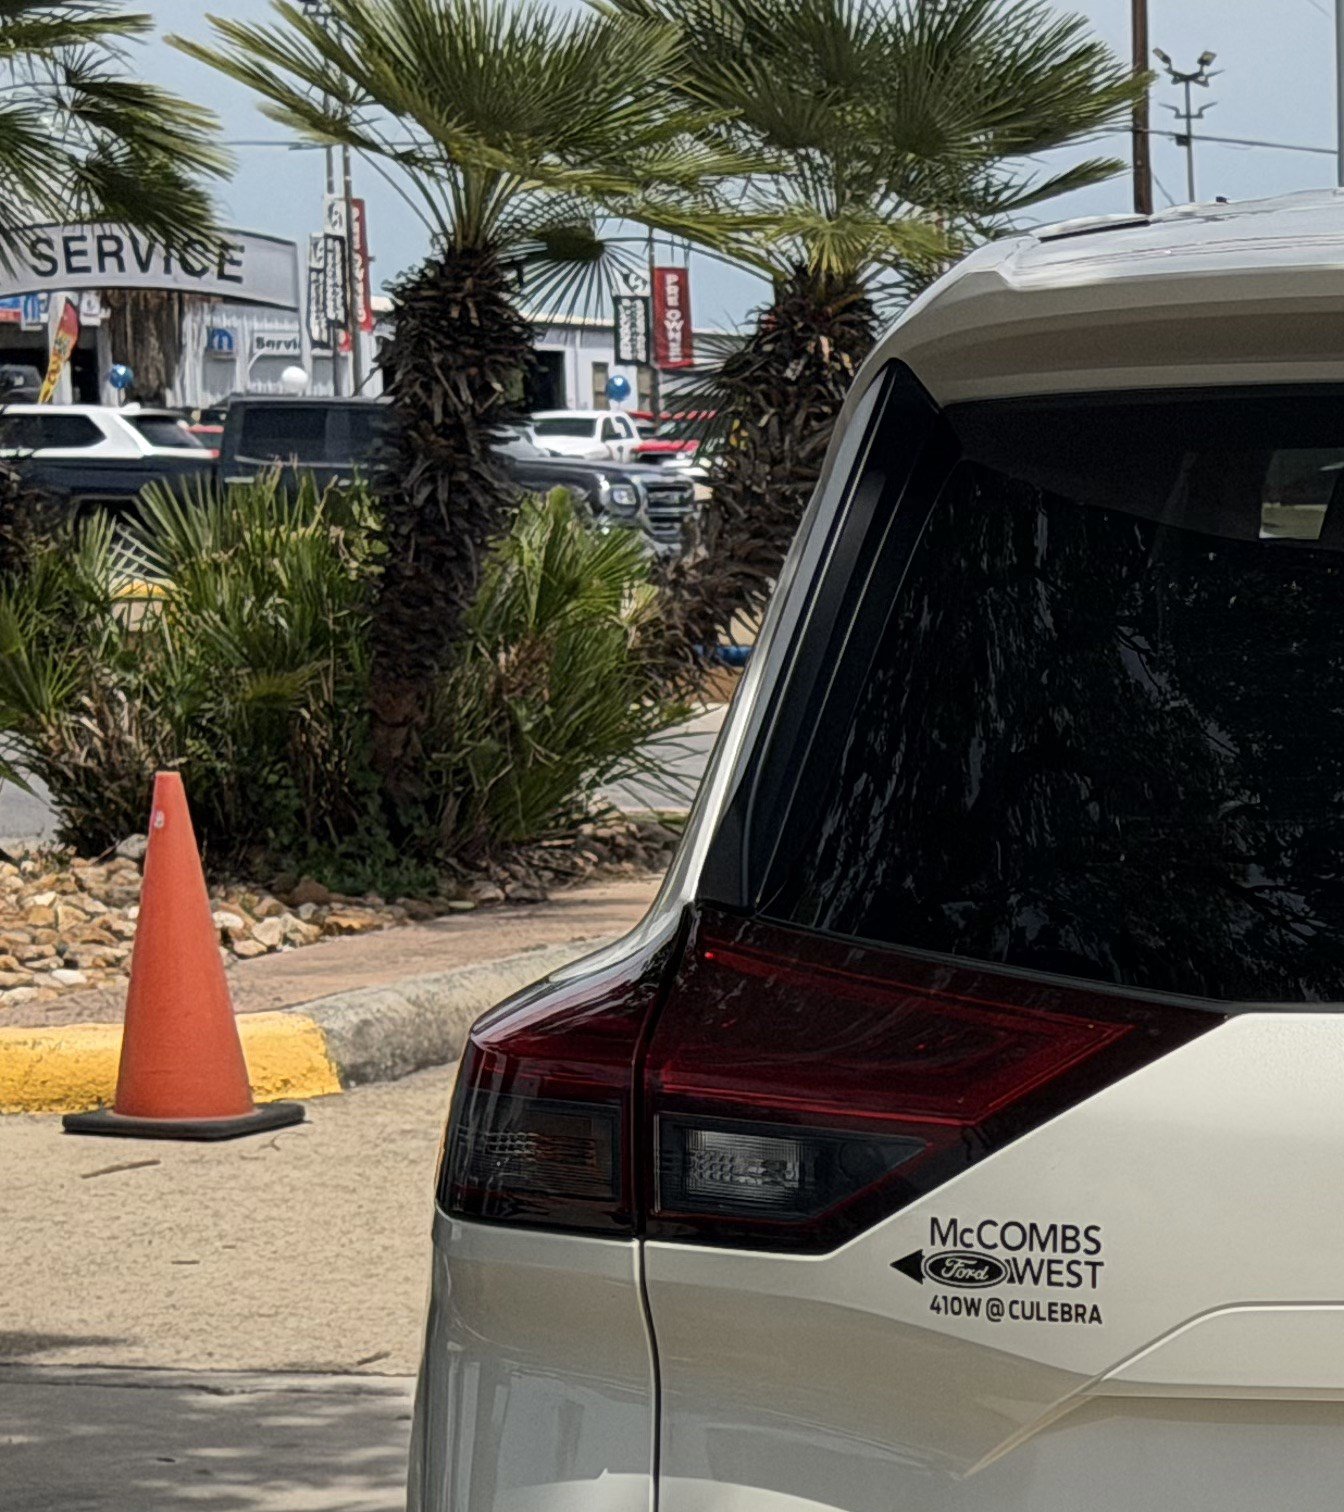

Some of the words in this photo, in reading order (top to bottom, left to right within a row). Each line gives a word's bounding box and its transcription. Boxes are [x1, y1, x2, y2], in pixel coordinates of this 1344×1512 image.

[30, 234, 245, 284] SERVICE
[930, 1217, 1101, 1255] McCOMBS
[941, 1256, 989, 1281] Ford
[1011, 1259, 1104, 1289] WEST
